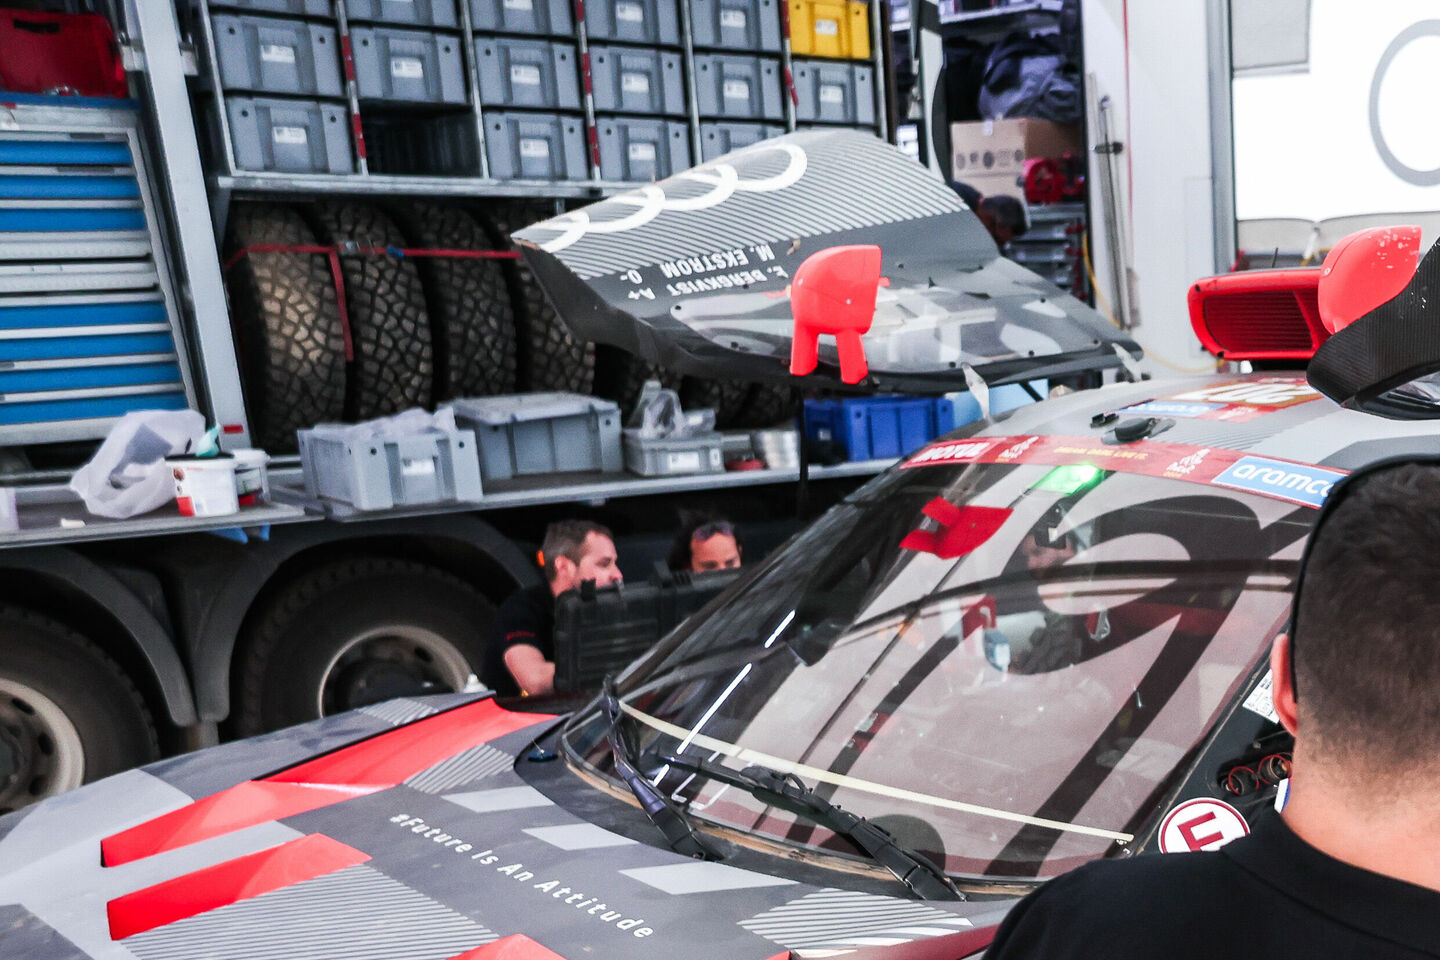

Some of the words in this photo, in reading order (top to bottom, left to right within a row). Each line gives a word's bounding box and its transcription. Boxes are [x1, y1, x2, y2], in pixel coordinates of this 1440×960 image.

[390, 813, 473, 854] #Future
[471, 849, 499, 866] Is
[497, 863, 534, 882] An
[533, 879, 655, 939] Attitude
